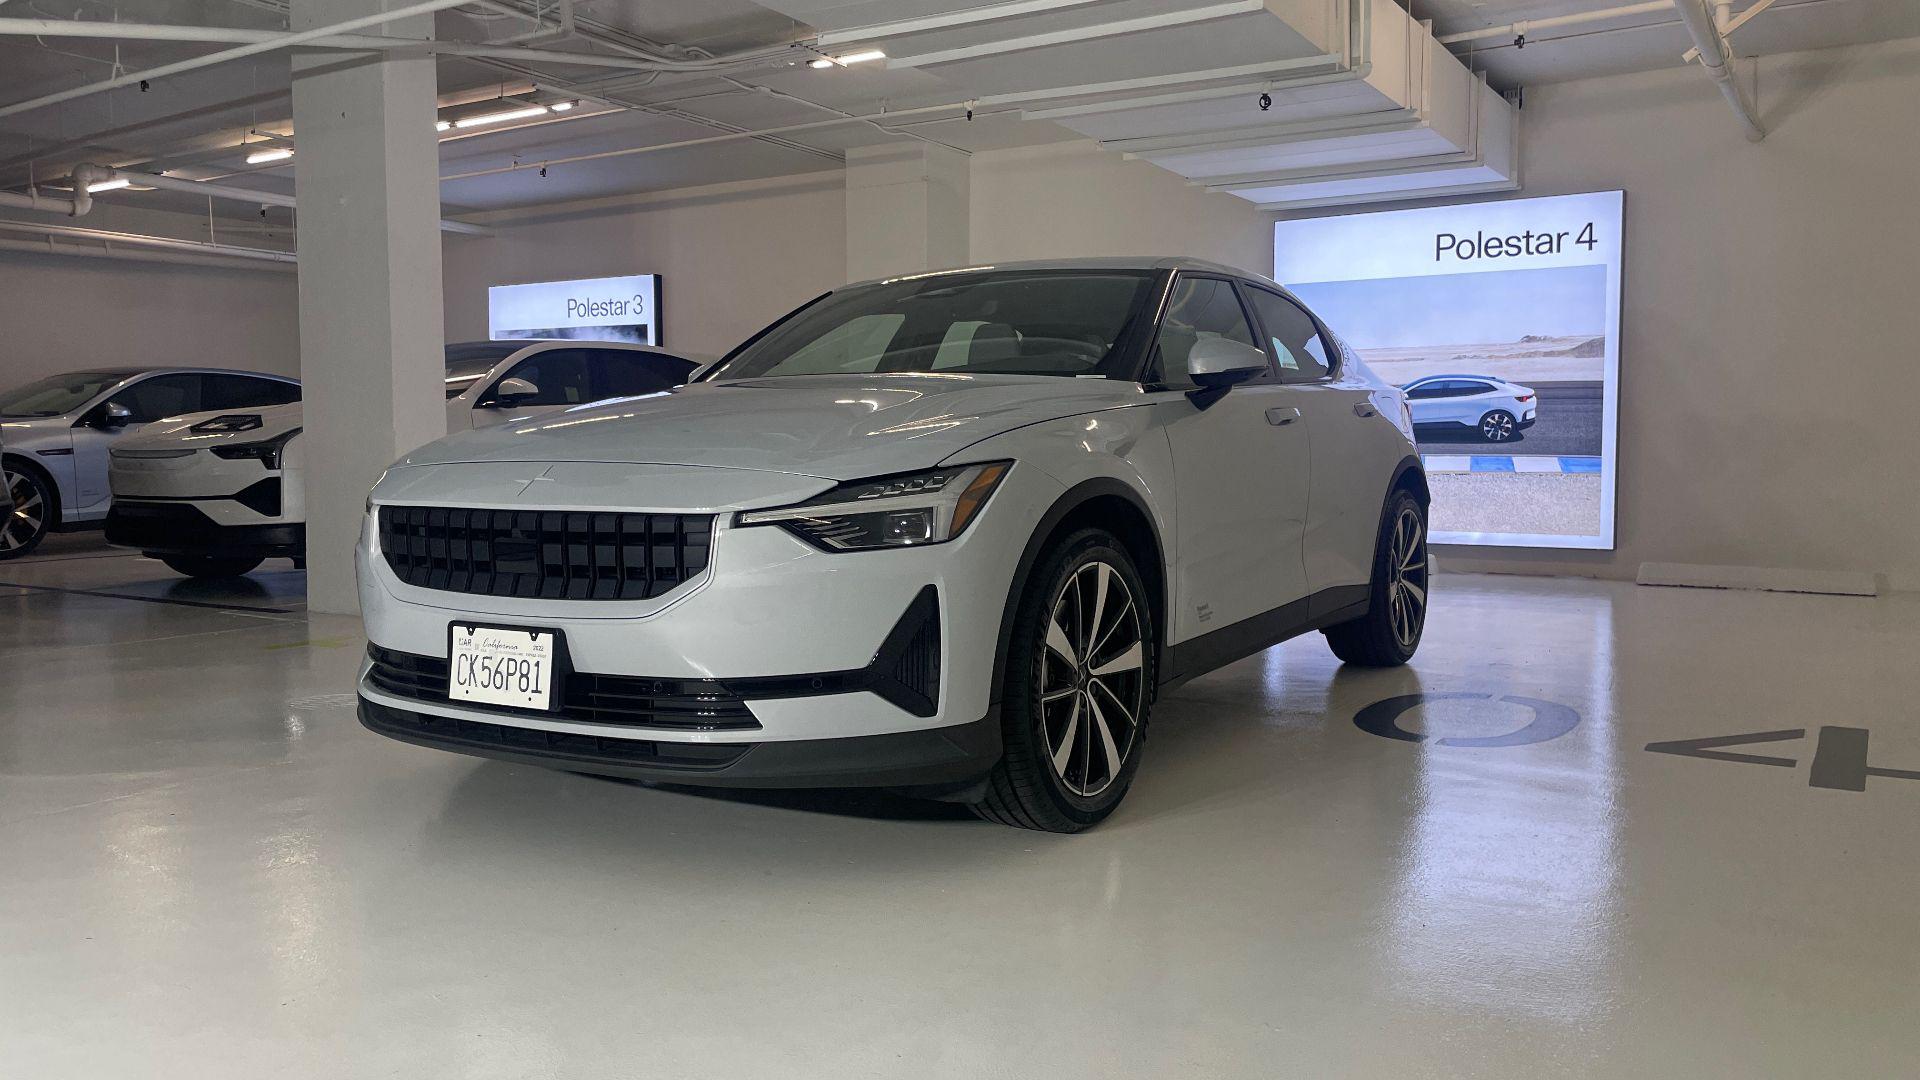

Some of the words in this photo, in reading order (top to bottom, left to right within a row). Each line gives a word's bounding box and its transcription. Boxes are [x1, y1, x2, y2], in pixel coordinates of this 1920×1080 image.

[1435, 230, 1569, 262] Polestar
[1574, 222, 1598, 251] 4
[567, 298, 630, 318] Polestar
[632, 294, 644, 315] 3
[482, 637, 519, 651] California
[457, 653, 543, 694] CK56P81
